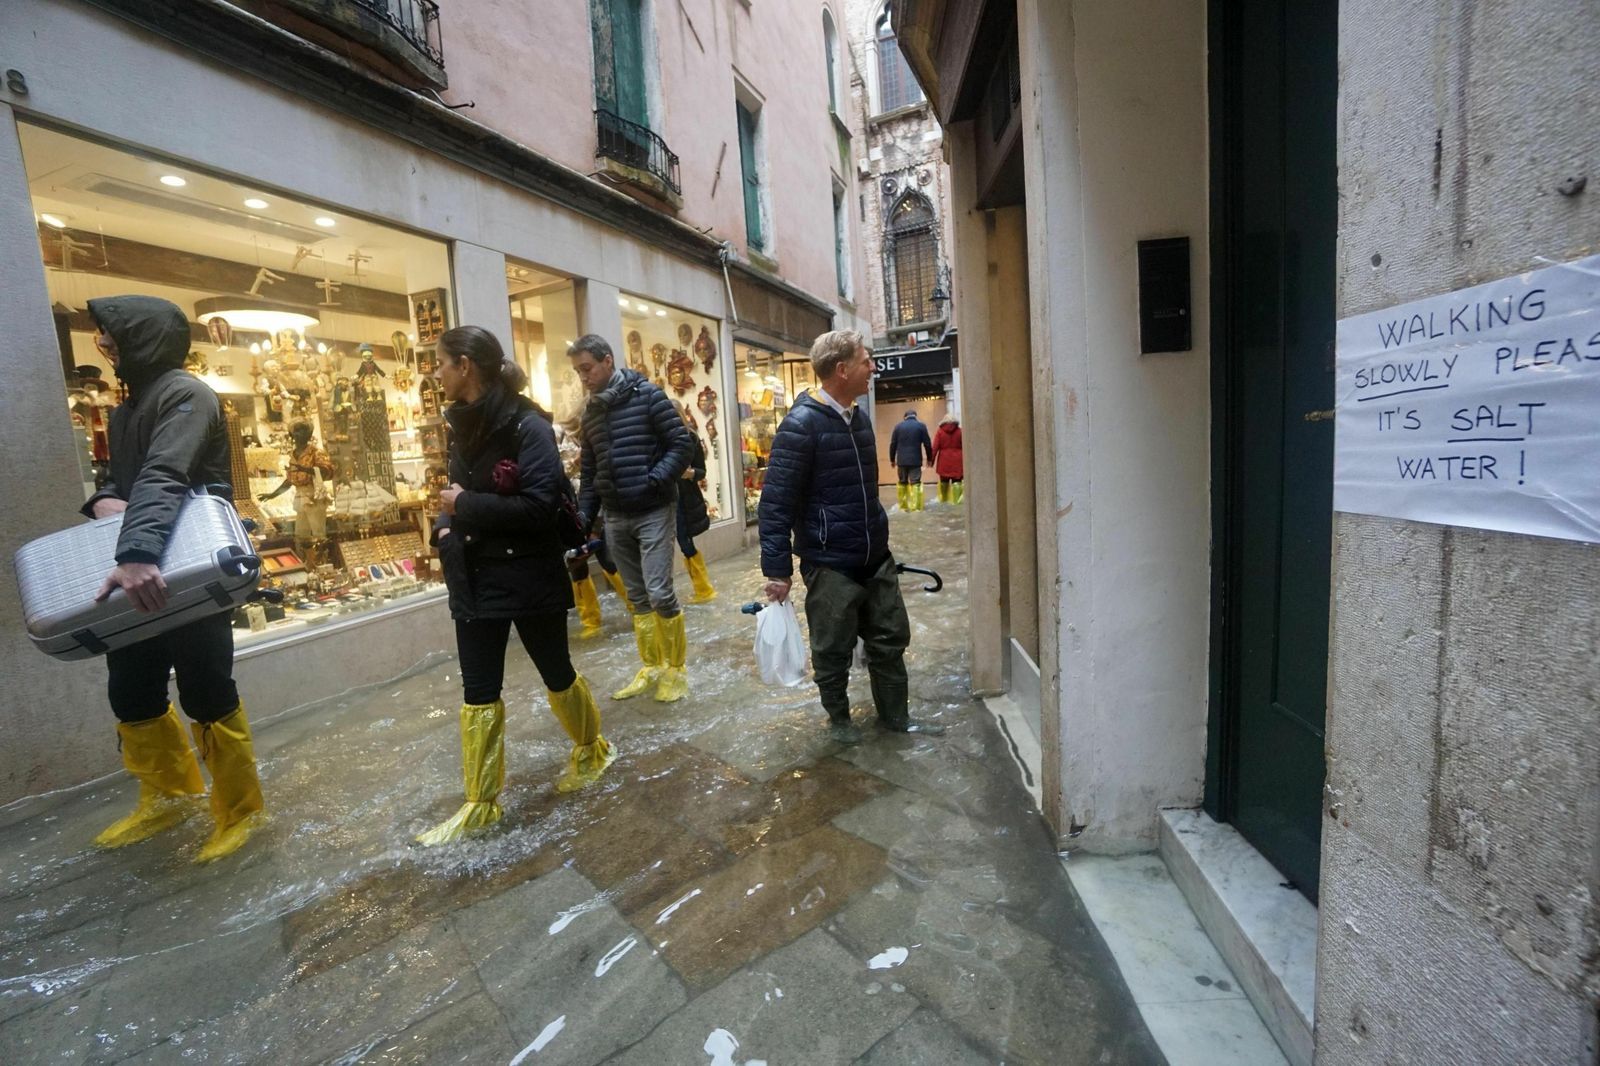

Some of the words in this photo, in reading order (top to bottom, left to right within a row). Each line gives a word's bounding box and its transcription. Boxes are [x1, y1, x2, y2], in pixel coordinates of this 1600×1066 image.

[1378, 289, 1546, 349] WALKING
[1355, 354, 1458, 389] SLOWLY
[1379, 407, 1421, 431] IT'S
[1451, 402, 1546, 435] SALT
[1397, 456, 1498, 480] WATER
